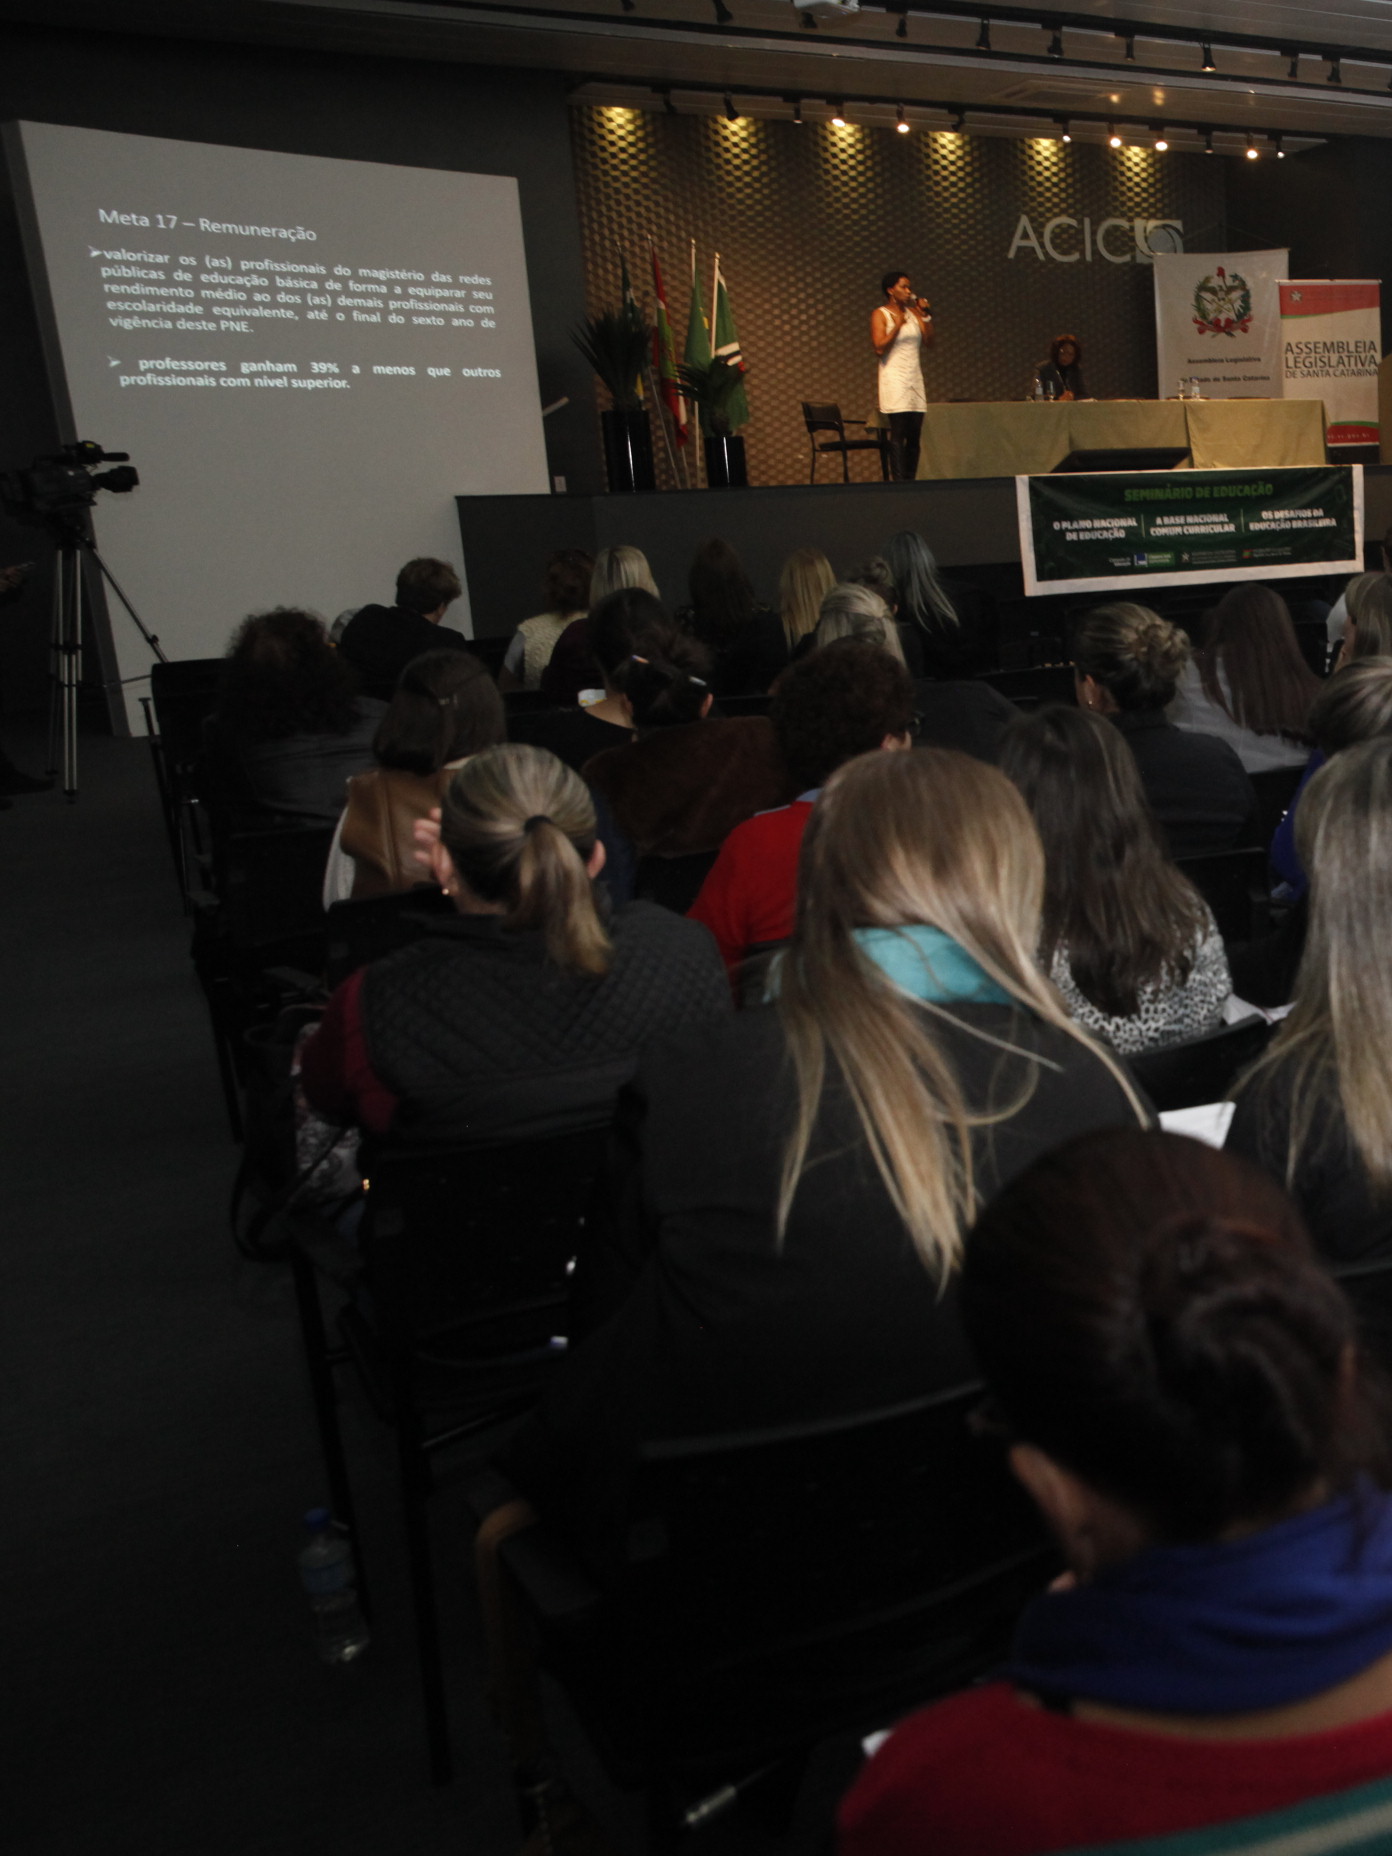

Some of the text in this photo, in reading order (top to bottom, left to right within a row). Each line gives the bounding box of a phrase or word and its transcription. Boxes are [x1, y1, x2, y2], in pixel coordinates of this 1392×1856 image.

[98, 208, 150, 228] Meta
[155, 214, 178, 229] 17
[199, 218, 317, 243] Remuneração
[1007, 214, 1131, 264] ACIC
[179, 255, 198, 266] os
[205, 255, 232, 270] (as)
[240, 259, 327, 276] profissionais
[334, 264, 351, 276] do
[358, 267, 425, 281] magistério
[431, 271, 453, 283] das
[458, 274, 492, 286] redes
[100, 265, 493, 300] públicas de educação básica de forma a equiparar seu
[103, 283, 495, 314] rendimento médio ao dos (as) demais profissionais com
[106, 300, 496, 329] escolaridade equivalente, até o final do sexto ano de
[108, 316, 254, 333] vigência deste PNE.
[1285, 341, 1378, 355] ASSEMBLEIA
[138, 357, 501, 380] professores ganham 39% a menos que outros
[1285, 355, 1379, 369] LEGISLATIVA
[119, 373, 217, 388] profissionais
[220, 376, 251, 387] com
[290, 377, 351, 391] superior.
[1285, 369, 1379, 379] DE SANTA CATARINA
[1124, 481, 1273, 501] SEMINÁRIO DE EDUCAÇÃO
[1156, 513, 1229, 525] A BASE NACIONAL
[1261, 508, 1324, 520] OS DESAFIOS DA
[1053, 517, 1138, 530] O PLANO NACIONAL
[1150, 523, 1236, 537] COMUM CURRICULAR
[1249, 517, 1337, 531] EDUCAÇÃO BRASILEIRA
[1066, 528, 1126, 541] DE EDUCAÇÃO
